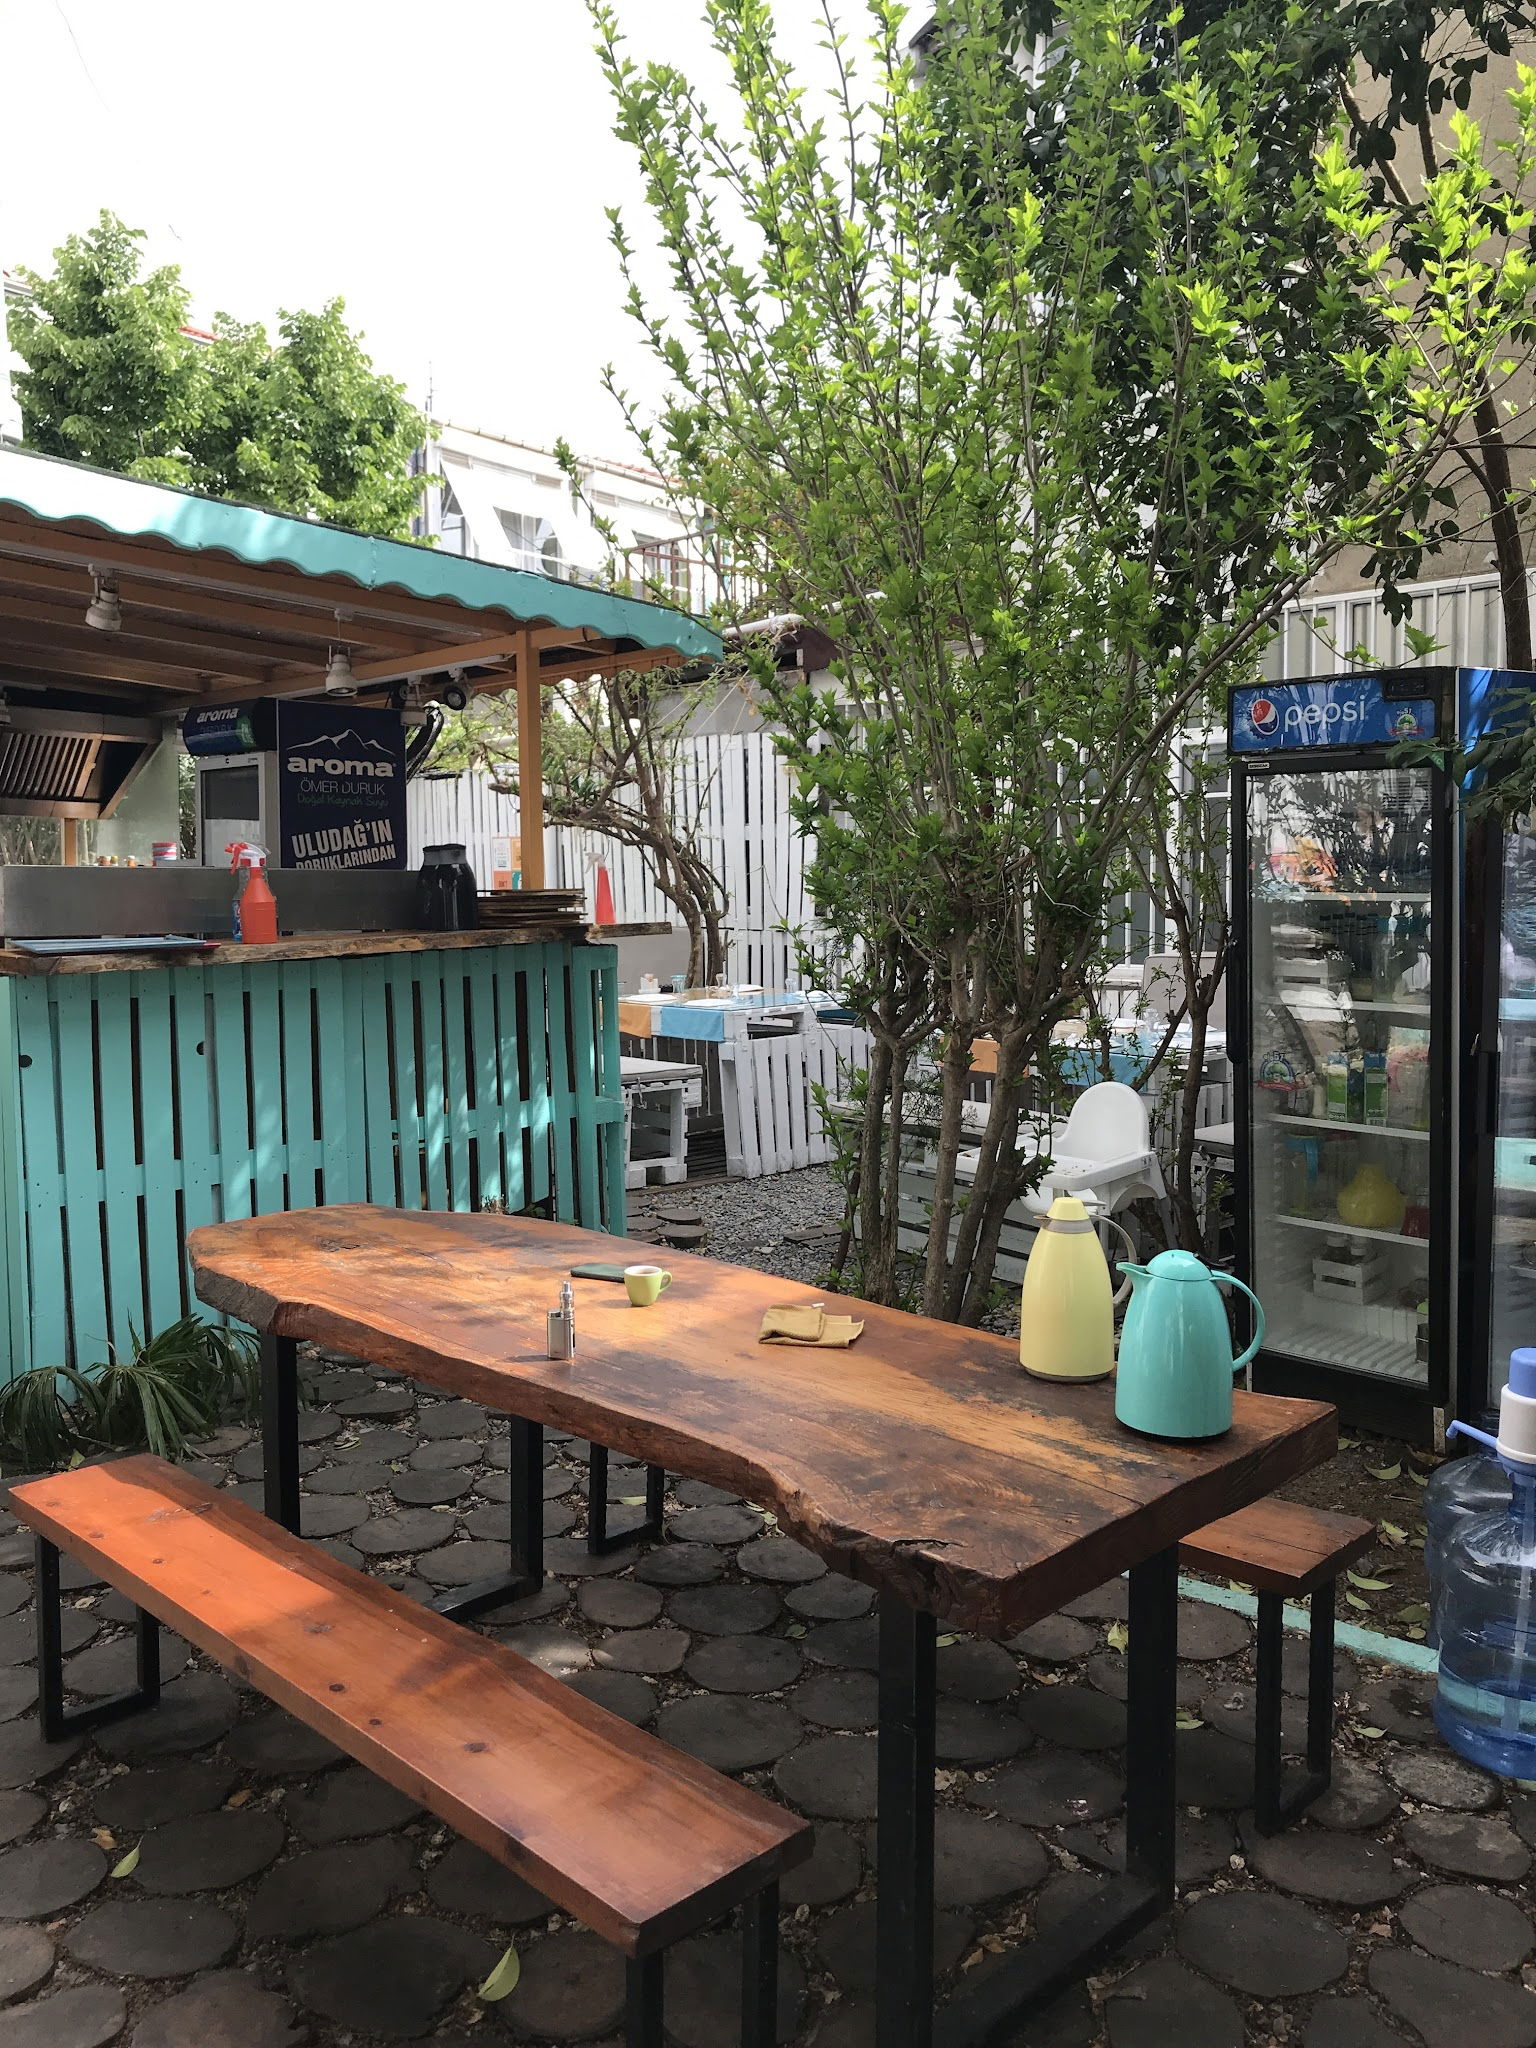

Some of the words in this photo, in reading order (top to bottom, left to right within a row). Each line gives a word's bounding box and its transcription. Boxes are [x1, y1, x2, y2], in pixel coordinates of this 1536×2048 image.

[196, 707, 240, 724] aroma
[1284, 695, 1366, 733] pepsi
[287, 755, 394, 778] aroma
[300, 777, 339, 793] ÖMER
[341, 781, 386, 796] DURUK
[291, 818, 394, 859] ULUDAĞ'IN
